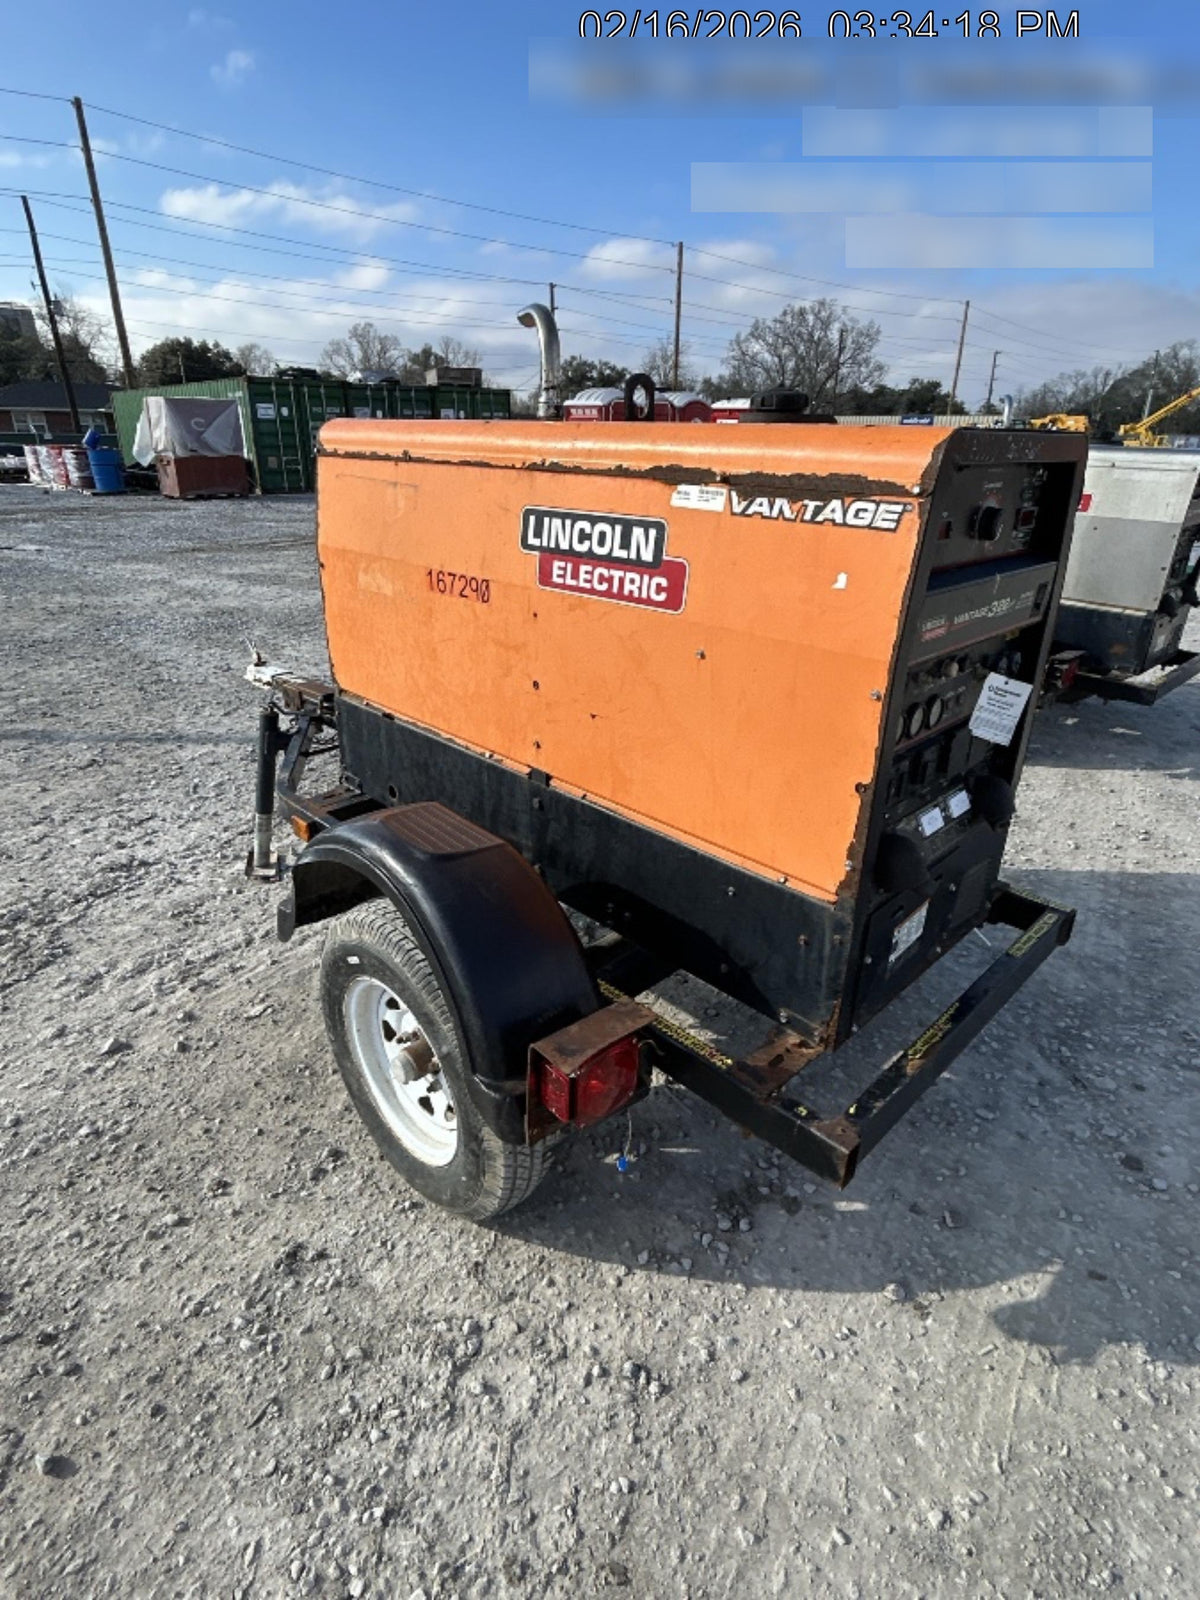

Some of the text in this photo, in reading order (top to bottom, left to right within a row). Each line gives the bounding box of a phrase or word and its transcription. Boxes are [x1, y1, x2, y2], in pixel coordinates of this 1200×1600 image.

[730, 489, 904, 530] VANTAGE
[527, 514, 657, 563] LINCOLN
[426, 568, 490, 603] 167290
[552, 559, 668, 602] ELECTRIC
